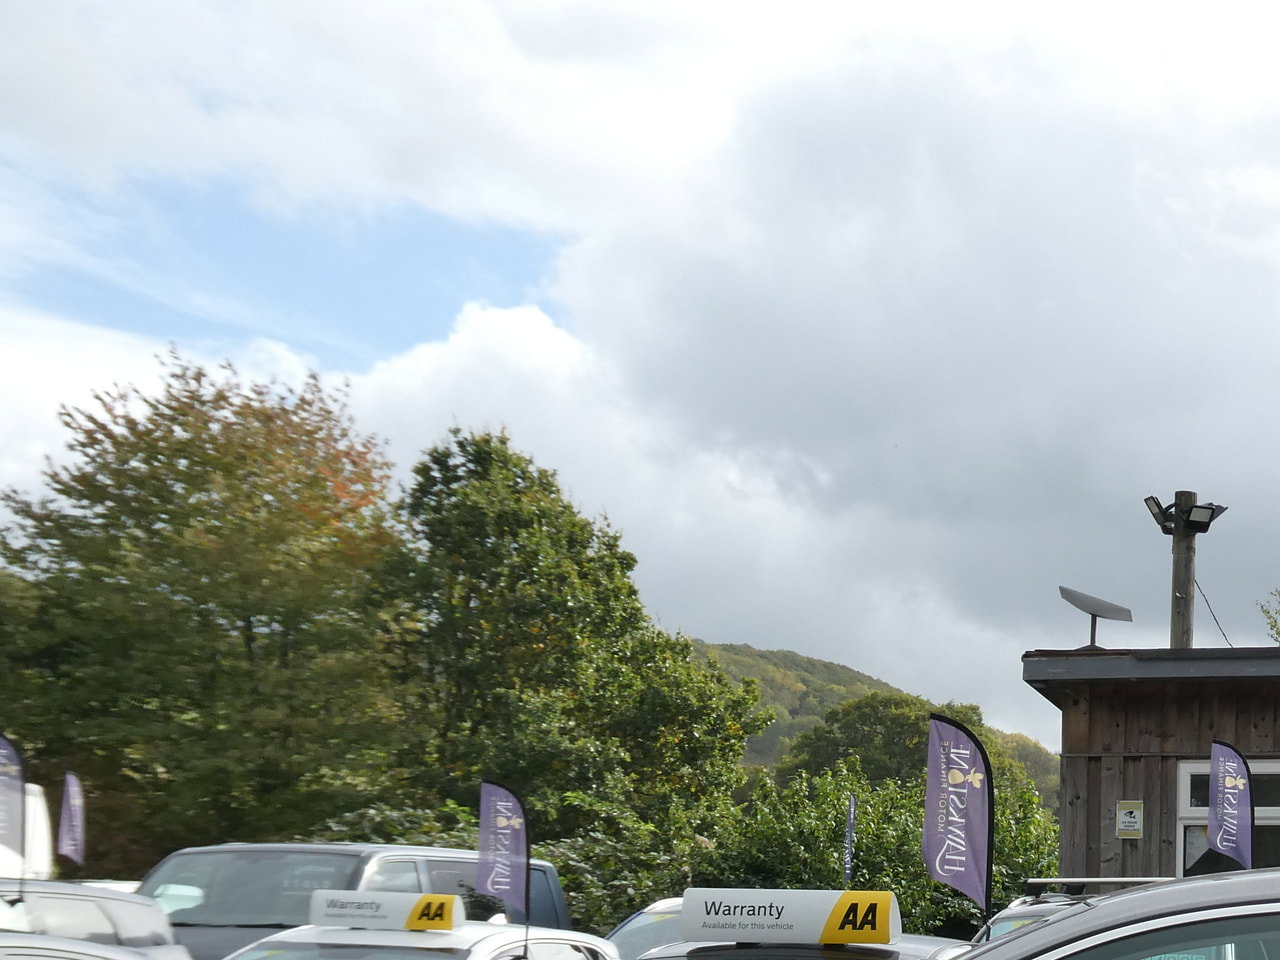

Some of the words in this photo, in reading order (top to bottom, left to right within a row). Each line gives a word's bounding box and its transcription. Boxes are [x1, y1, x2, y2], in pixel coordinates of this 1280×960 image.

[326, 899, 381, 912] Warranty
[418, 902, 445, 920] AA
[704, 901, 785, 919] Warranty
[701, 921, 737, 930] Available
[738, 921, 750, 930] for
[751, 921, 765, 930] this
[766, 921, 794, 930] vehicle
[838, 903, 877, 930] AA
